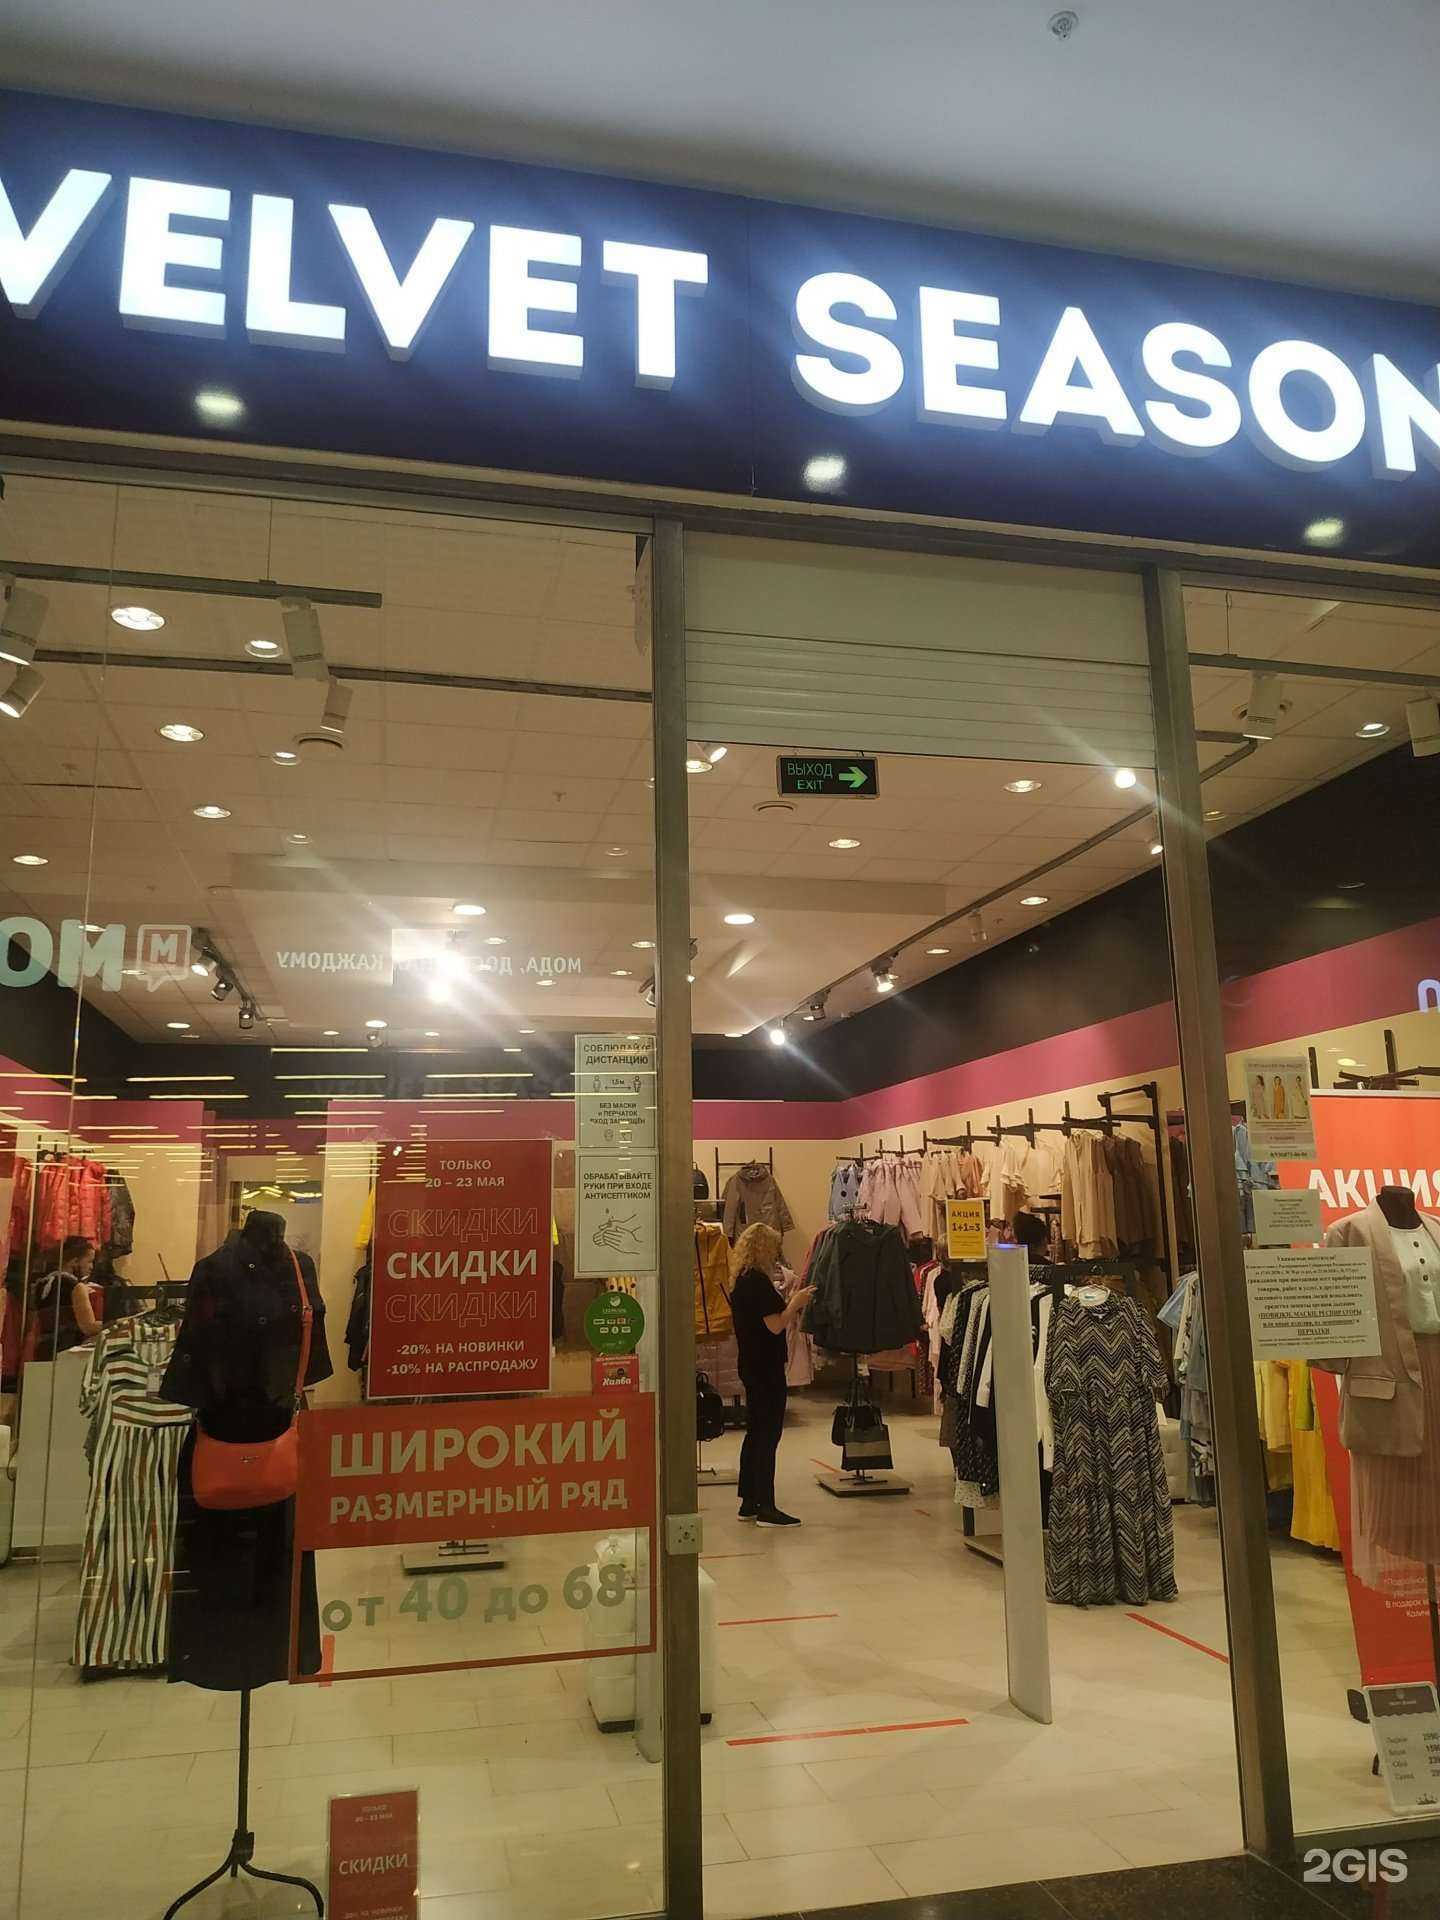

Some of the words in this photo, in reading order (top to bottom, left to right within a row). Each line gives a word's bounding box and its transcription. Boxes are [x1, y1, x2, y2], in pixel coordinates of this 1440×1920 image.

[0, 168, 710, 388] VELVET
[787, 763, 833, 779] ВЫХОД
[797, 779, 824, 790] EXIT
[586, 1056, 648, 1065] ДИСТАНЦИЮ
[440, 1159, 492, 1171] ТОЛЬКО
[425, 1177, 442, 1188] 20
[457, 1176, 473, 1187] 23
[477, 1176, 505, 1187] МАЯ
[584, 1172, 652, 1180] ОБРАБАТЫВАЙТЕ
[584, 1182, 606, 1190] РУКИ
[607, 1182, 624, 1190] ПРИ
[625, 1182, 652, 1190] ВХОДЕ
[584, 1191, 651, 1200] АНТИСЕПТИКОМ
[387, 1207, 539, 1243] СКИДКИ
[951, 1222, 981, 1232] 1+1=3
[387, 1249, 537, 1285] СКИДКИ
[385, 1290, 537, 1328] СКИДКИ
[397, 1343, 431, 1355] -20%
[436, 1342, 453, 1354] НА
[459, 1340, 525, 1353] НОВИНКИ
[386, 1363, 421, 1375] -10%
[426, 1362, 444, 1373] НА
[448, 1359, 539, 1373] РАСПРОДАЖУ
[330, 1408, 627, 1478] ШИРОКИЙ
[329, 1478, 550, 1524] РАЗМЕРНЫЙ
[560, 1478, 628, 1510] РЯД
[322, 1595, 384, 1632] от
[399, 1576, 469, 1622] 40
[484, 1583, 549, 1624] до
[563, 1564, 627, 1610] 68
[338, 1853, 409, 1875] СКИДКИ
